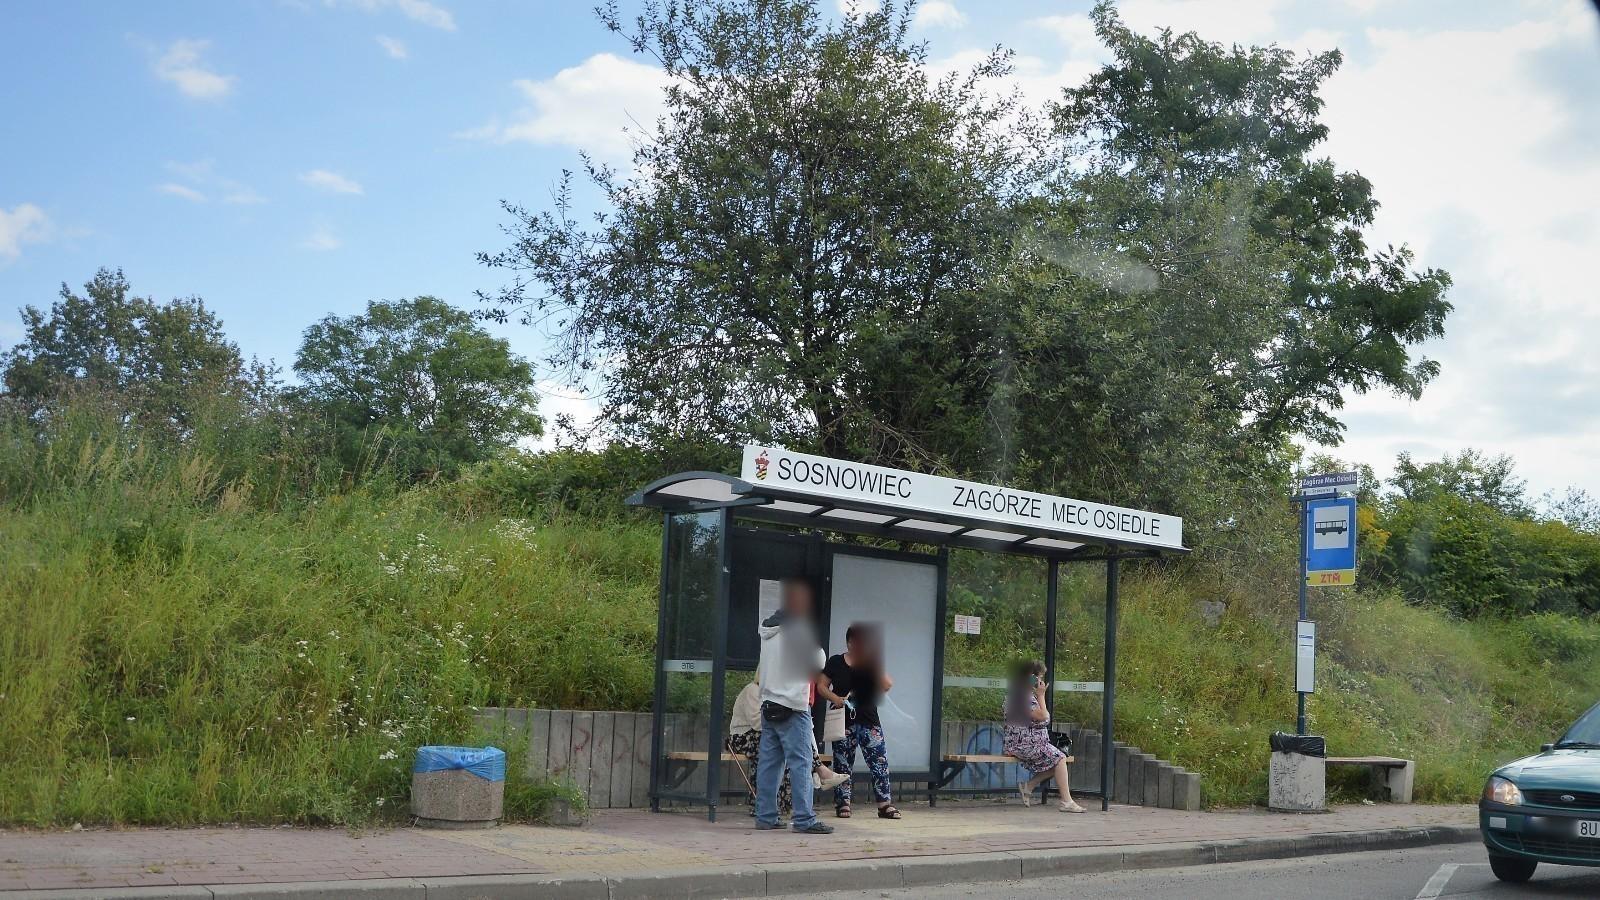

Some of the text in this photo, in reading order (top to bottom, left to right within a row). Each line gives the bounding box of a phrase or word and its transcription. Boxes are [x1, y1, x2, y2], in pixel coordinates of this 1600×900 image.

[777, 457, 912, 499] SOSNOWIEC
[952, 486, 1160, 537] ZAGÓRZE MEC OSIEDLE
[1320, 572, 1341, 584] ZTM
